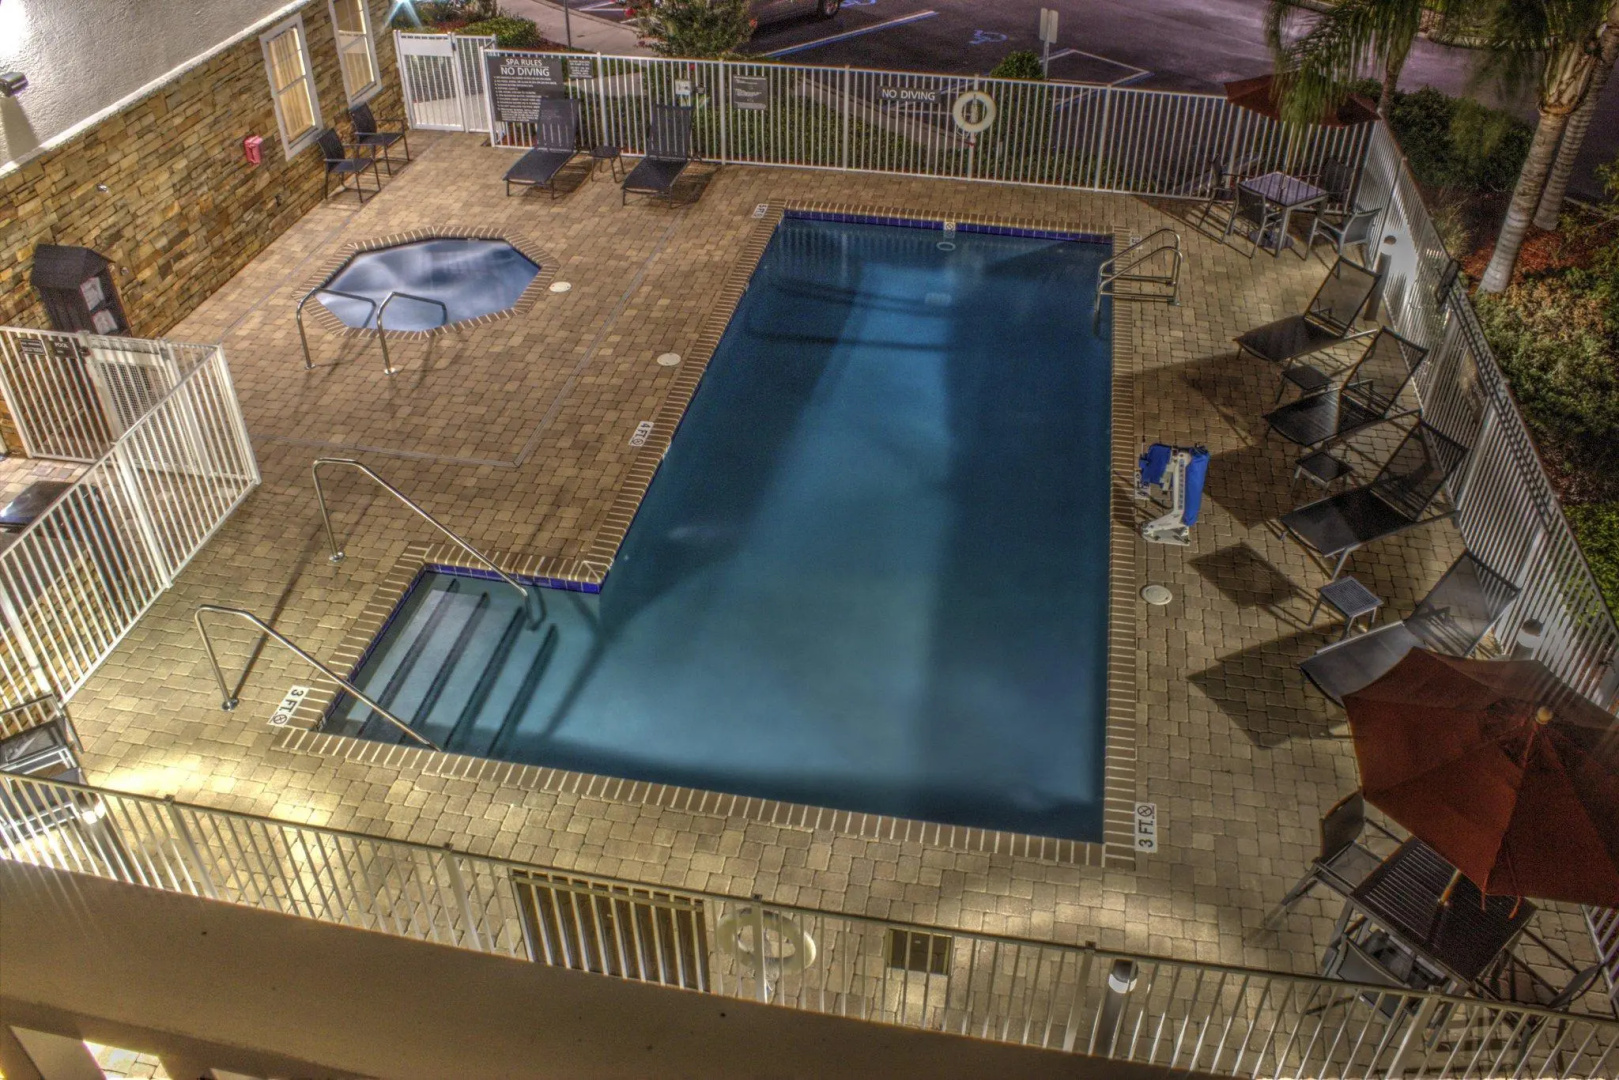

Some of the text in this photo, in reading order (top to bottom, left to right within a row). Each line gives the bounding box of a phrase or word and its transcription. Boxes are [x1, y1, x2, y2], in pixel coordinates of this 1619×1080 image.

[505, 58, 543, 67] SPA RULES
[500, 67, 550, 77] NO DIVING
[882, 89, 936, 101] NO DIVING
[1138, 839, 1154, 848] 3
